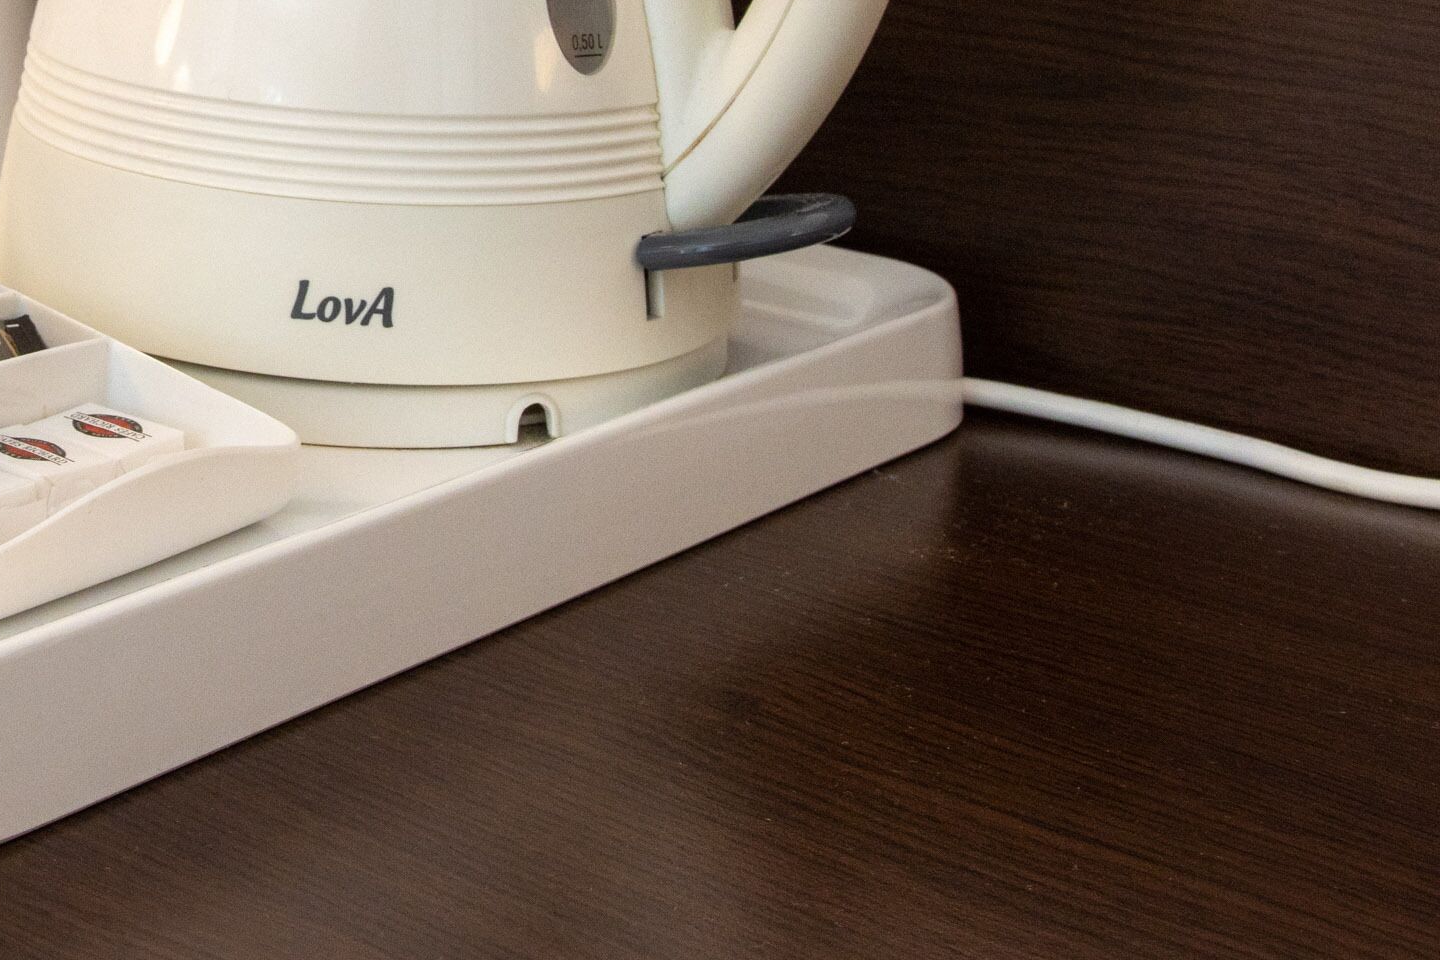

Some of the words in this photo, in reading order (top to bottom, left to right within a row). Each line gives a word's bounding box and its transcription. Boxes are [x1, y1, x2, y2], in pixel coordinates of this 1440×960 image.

[571, 34, 596, 51] 0,50
[597, 33, 603, 50] L
[290, 279, 395, 329] LovA
